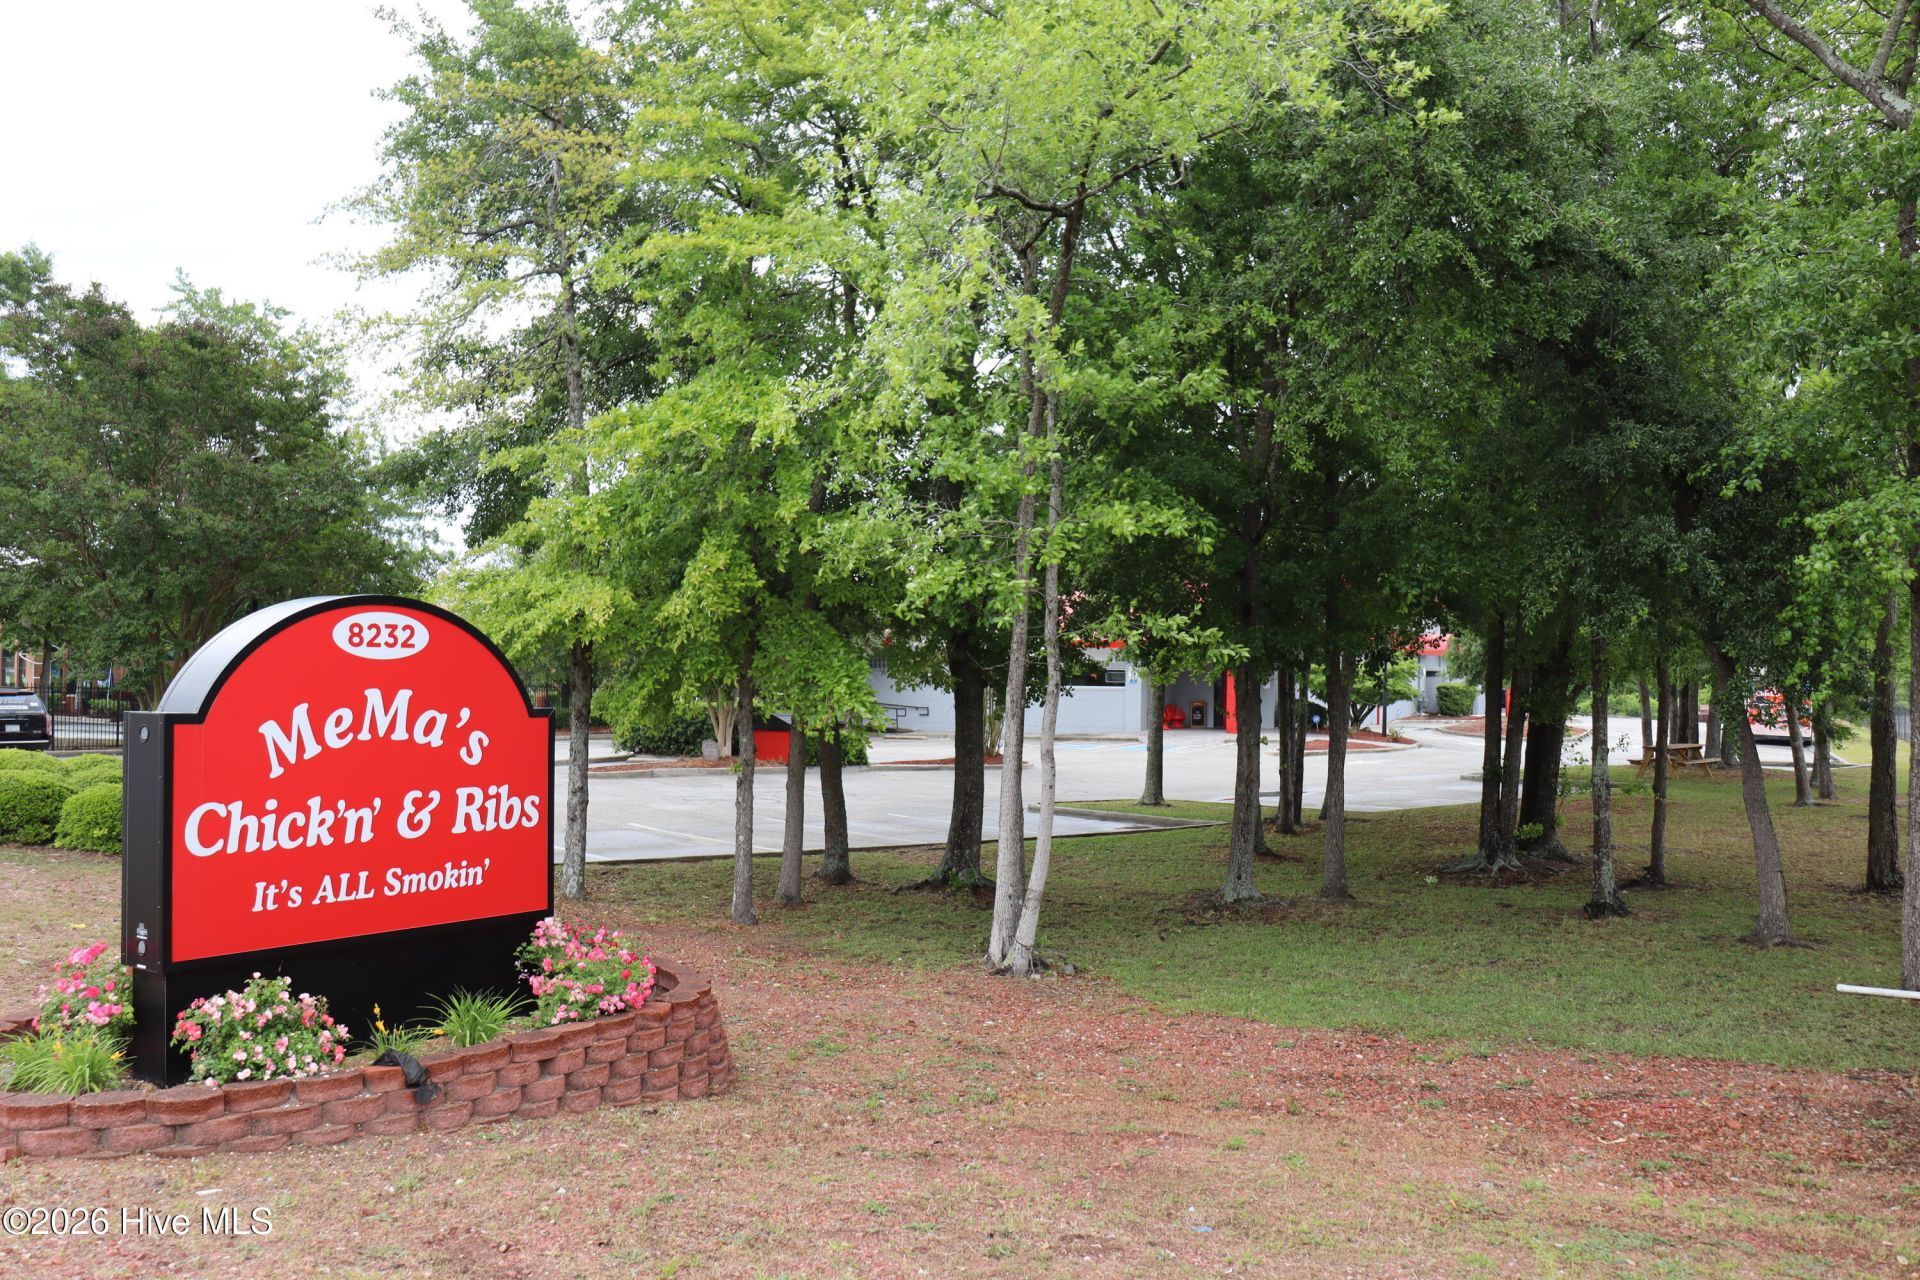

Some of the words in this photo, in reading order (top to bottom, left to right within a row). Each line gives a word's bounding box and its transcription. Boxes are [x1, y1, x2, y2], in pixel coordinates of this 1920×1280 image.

[348, 622, 415, 648] 8232
[258, 688, 489, 779] MeMa's
[184, 796, 381, 857] Chick'n'
[397, 790, 441, 839] &
[451, 784, 540, 834] Ribs
[252, 879, 303, 912] It's
[311, 871, 375, 905] ALL
[383, 858, 490, 896] Smokin'
